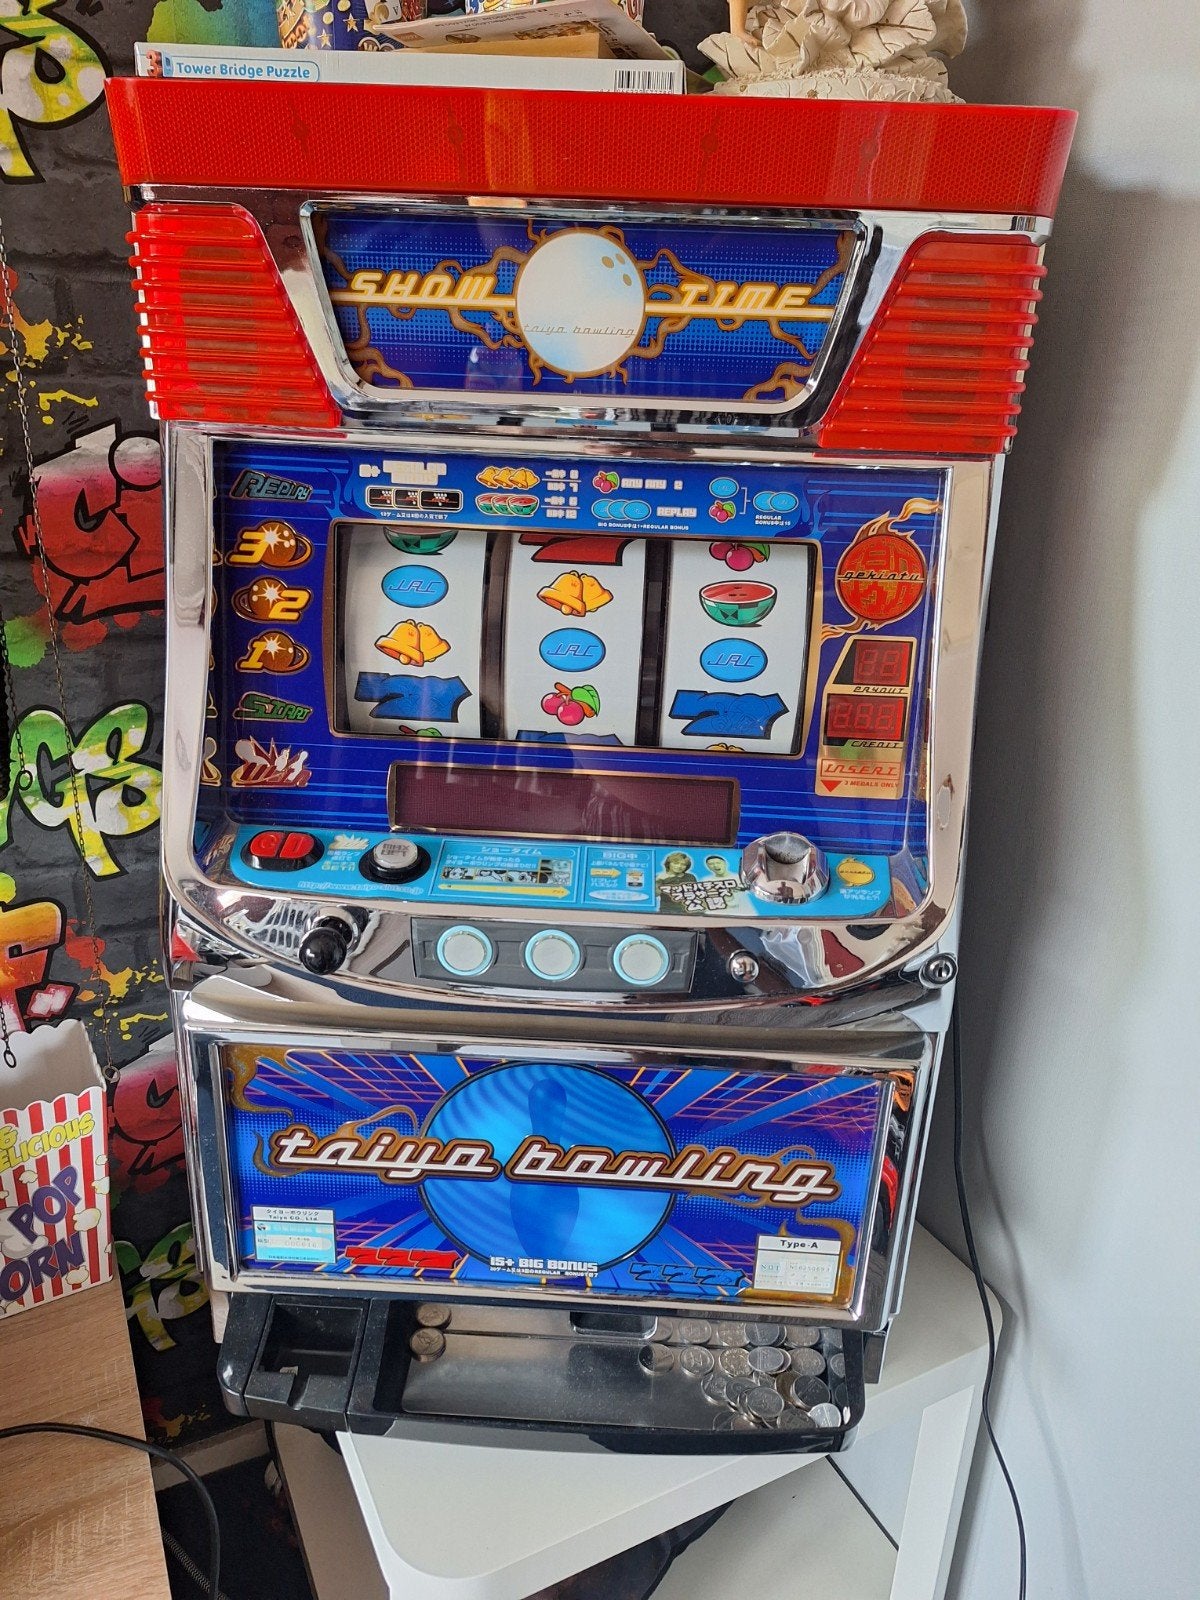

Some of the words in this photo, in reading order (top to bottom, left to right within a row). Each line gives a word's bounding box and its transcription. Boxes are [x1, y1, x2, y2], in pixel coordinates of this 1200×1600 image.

[176, 62, 217, 76] Tower
[220, 64, 263, 79] Bridge
[266, 65, 310, 79] Puzzle
[679, 283, 813, 312] TIME
[656, 506, 697, 518] REPLAY
[481, 846, 542, 855] ショータイム
[278, 1131, 495, 1179] taiyo
[512, 1143, 836, 1202] bowling
[9, 1165, 81, 1244] POP
[780, 1239, 818, 1249] Type-A
[490, 1256, 515, 1267] 15+
[518, 1258, 544, 1269] BIG
[547, 1259, 598, 1272] BONUS
